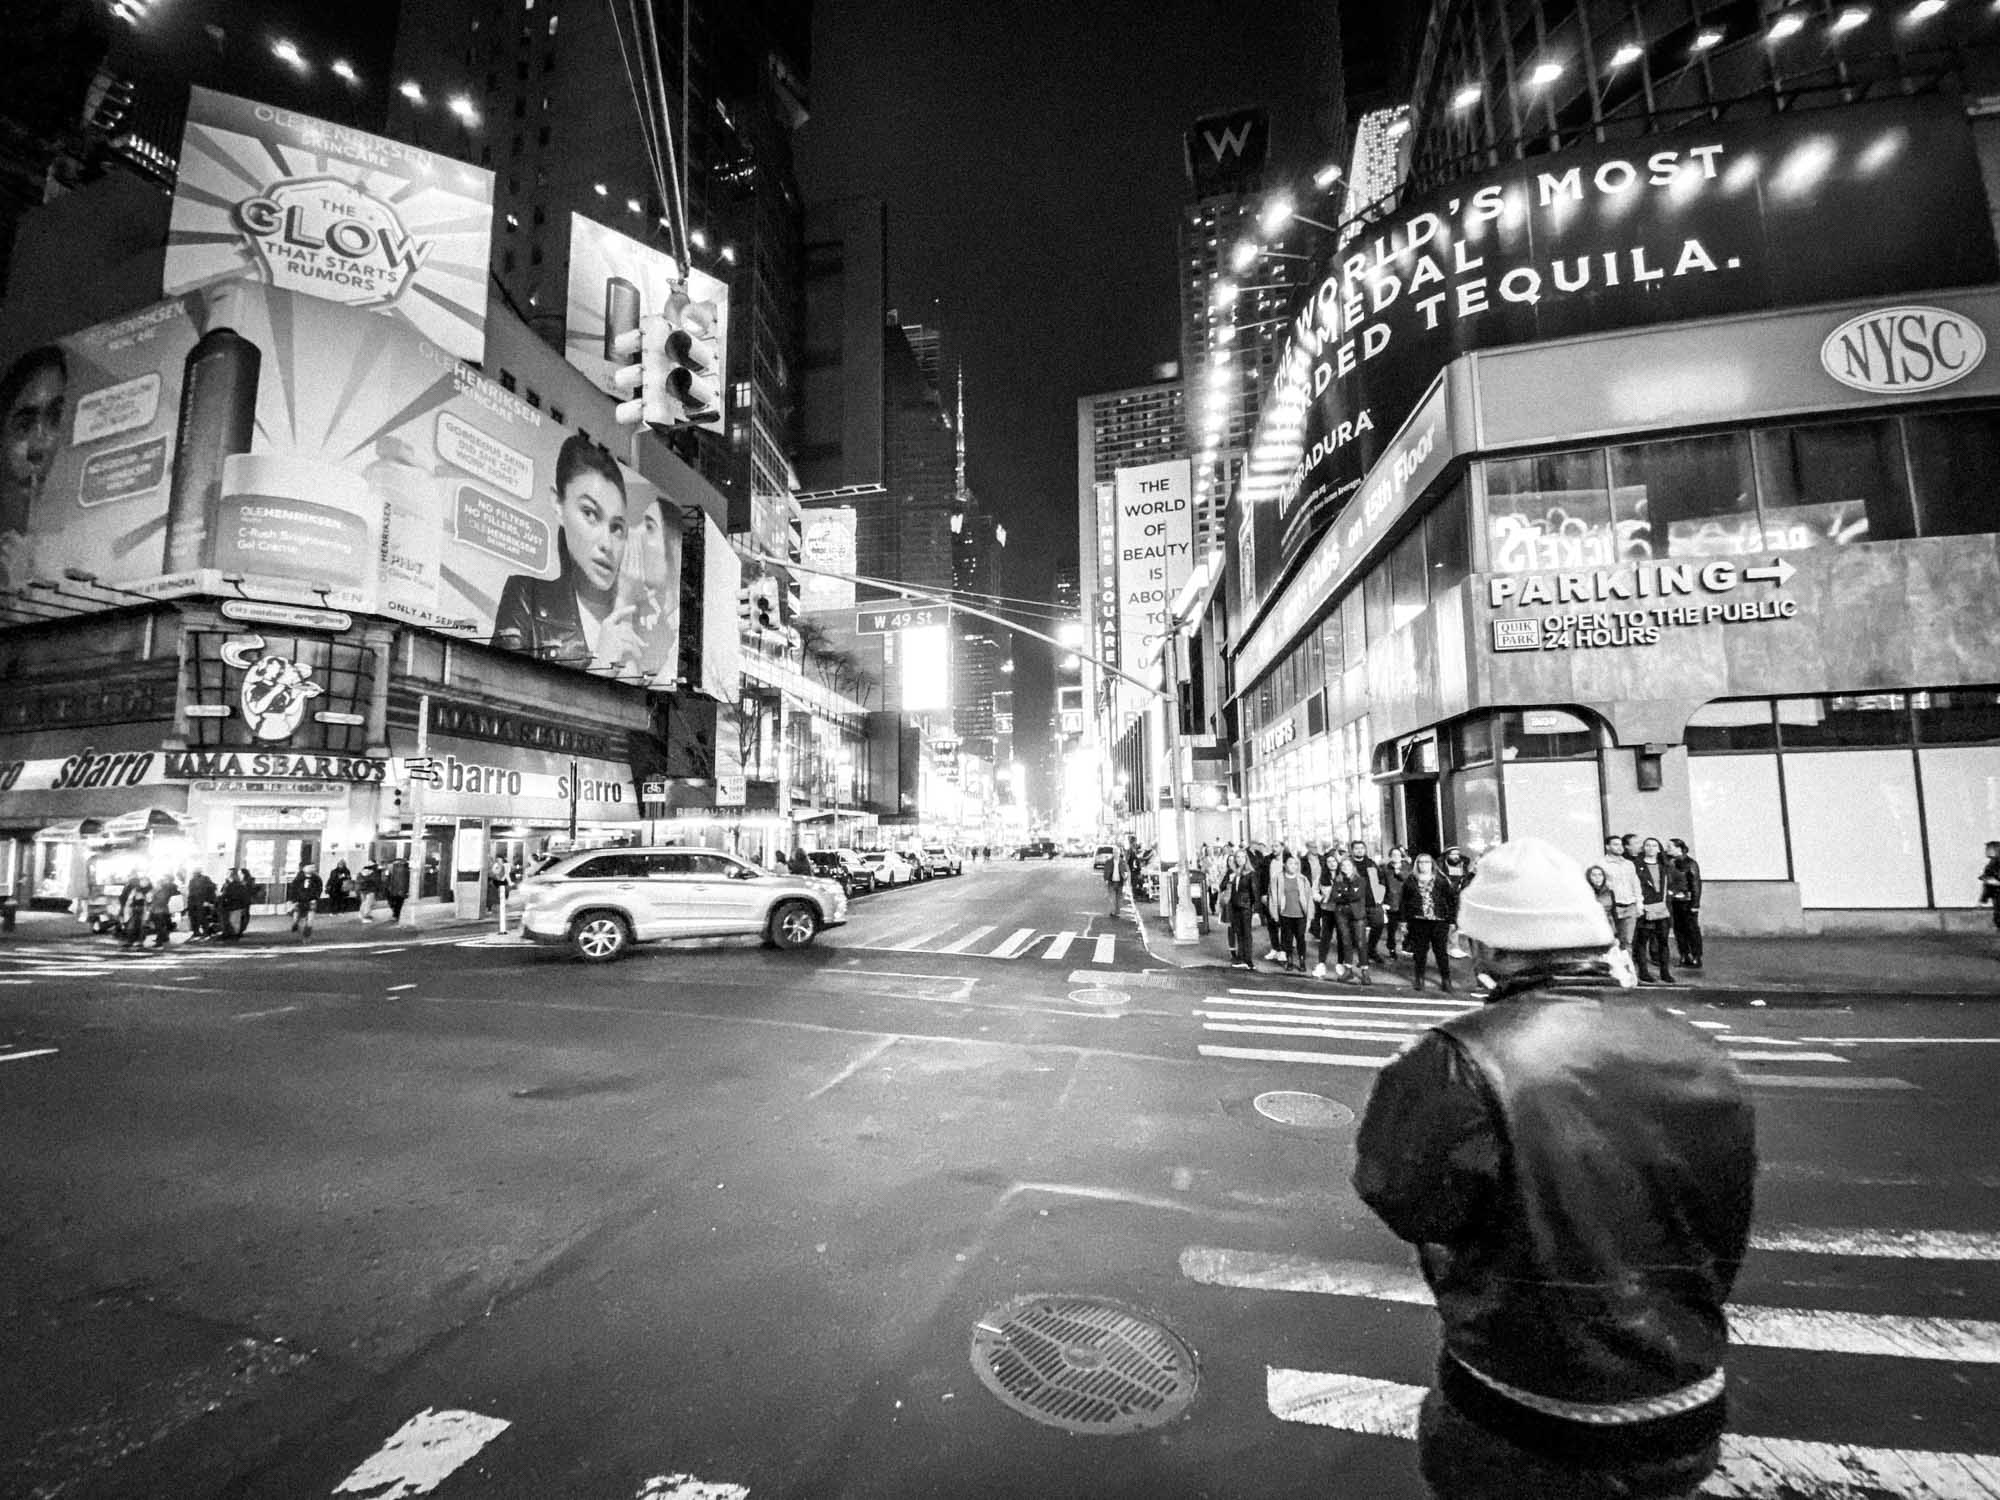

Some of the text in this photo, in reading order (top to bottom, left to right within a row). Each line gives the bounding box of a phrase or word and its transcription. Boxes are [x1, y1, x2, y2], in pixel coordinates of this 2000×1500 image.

[1203, 121, 1252, 162] W
[319, 198, 356, 217] THE
[231, 196, 436, 273] GLOW
[1296, 186, 1504, 342] WORLD'S
[1537, 143, 1724, 207] MOST
[265, 241, 398, 283] THAT STARTS
[287, 261, 376, 291] RUMORS
[1316, 239, 1484, 358] MEDAL
[1415, 239, 1740, 330] TEQUILA.
[1839, 314, 1967, 385] NYSC
[453, 379, 514, 423] SKINCARE
[1394, 424, 1436, 493] Floor
[1139, 479, 1171, 494] THE
[241, 506, 343, 530] OLEHENRIKSEN
[478, 499, 494, 514] NO
[1125, 499, 1187, 518] WORLD
[464, 503, 481, 519] NO
[523, 532, 544, 547] JUST
[1144, 523, 1166, 537] OF
[1123, 542, 1190, 562] BEAUTY
[1101, 495, 1116, 662] TIMES SQUARE
[1149, 568, 1163, 581] IS
[1490, 560, 1738, 608] PARKING
[1128, 588, 1183, 604] ABOUT
[388, 601, 418, 616] ONLY
[419, 611, 432, 622] AT
[874, 611, 933, 629] W 49 St
[1544, 599, 1798, 632] OPEN TO THE PUBLIC
[1501, 621, 1533, 635] QUIK
[1501, 634, 1535, 647] PARK
[1544, 626, 1661, 651] 24 HOURS
[51, 746, 156, 790] sbarro
[253, 754, 387, 782] SBARRO'S
[428, 755, 522, 797] sbarro
